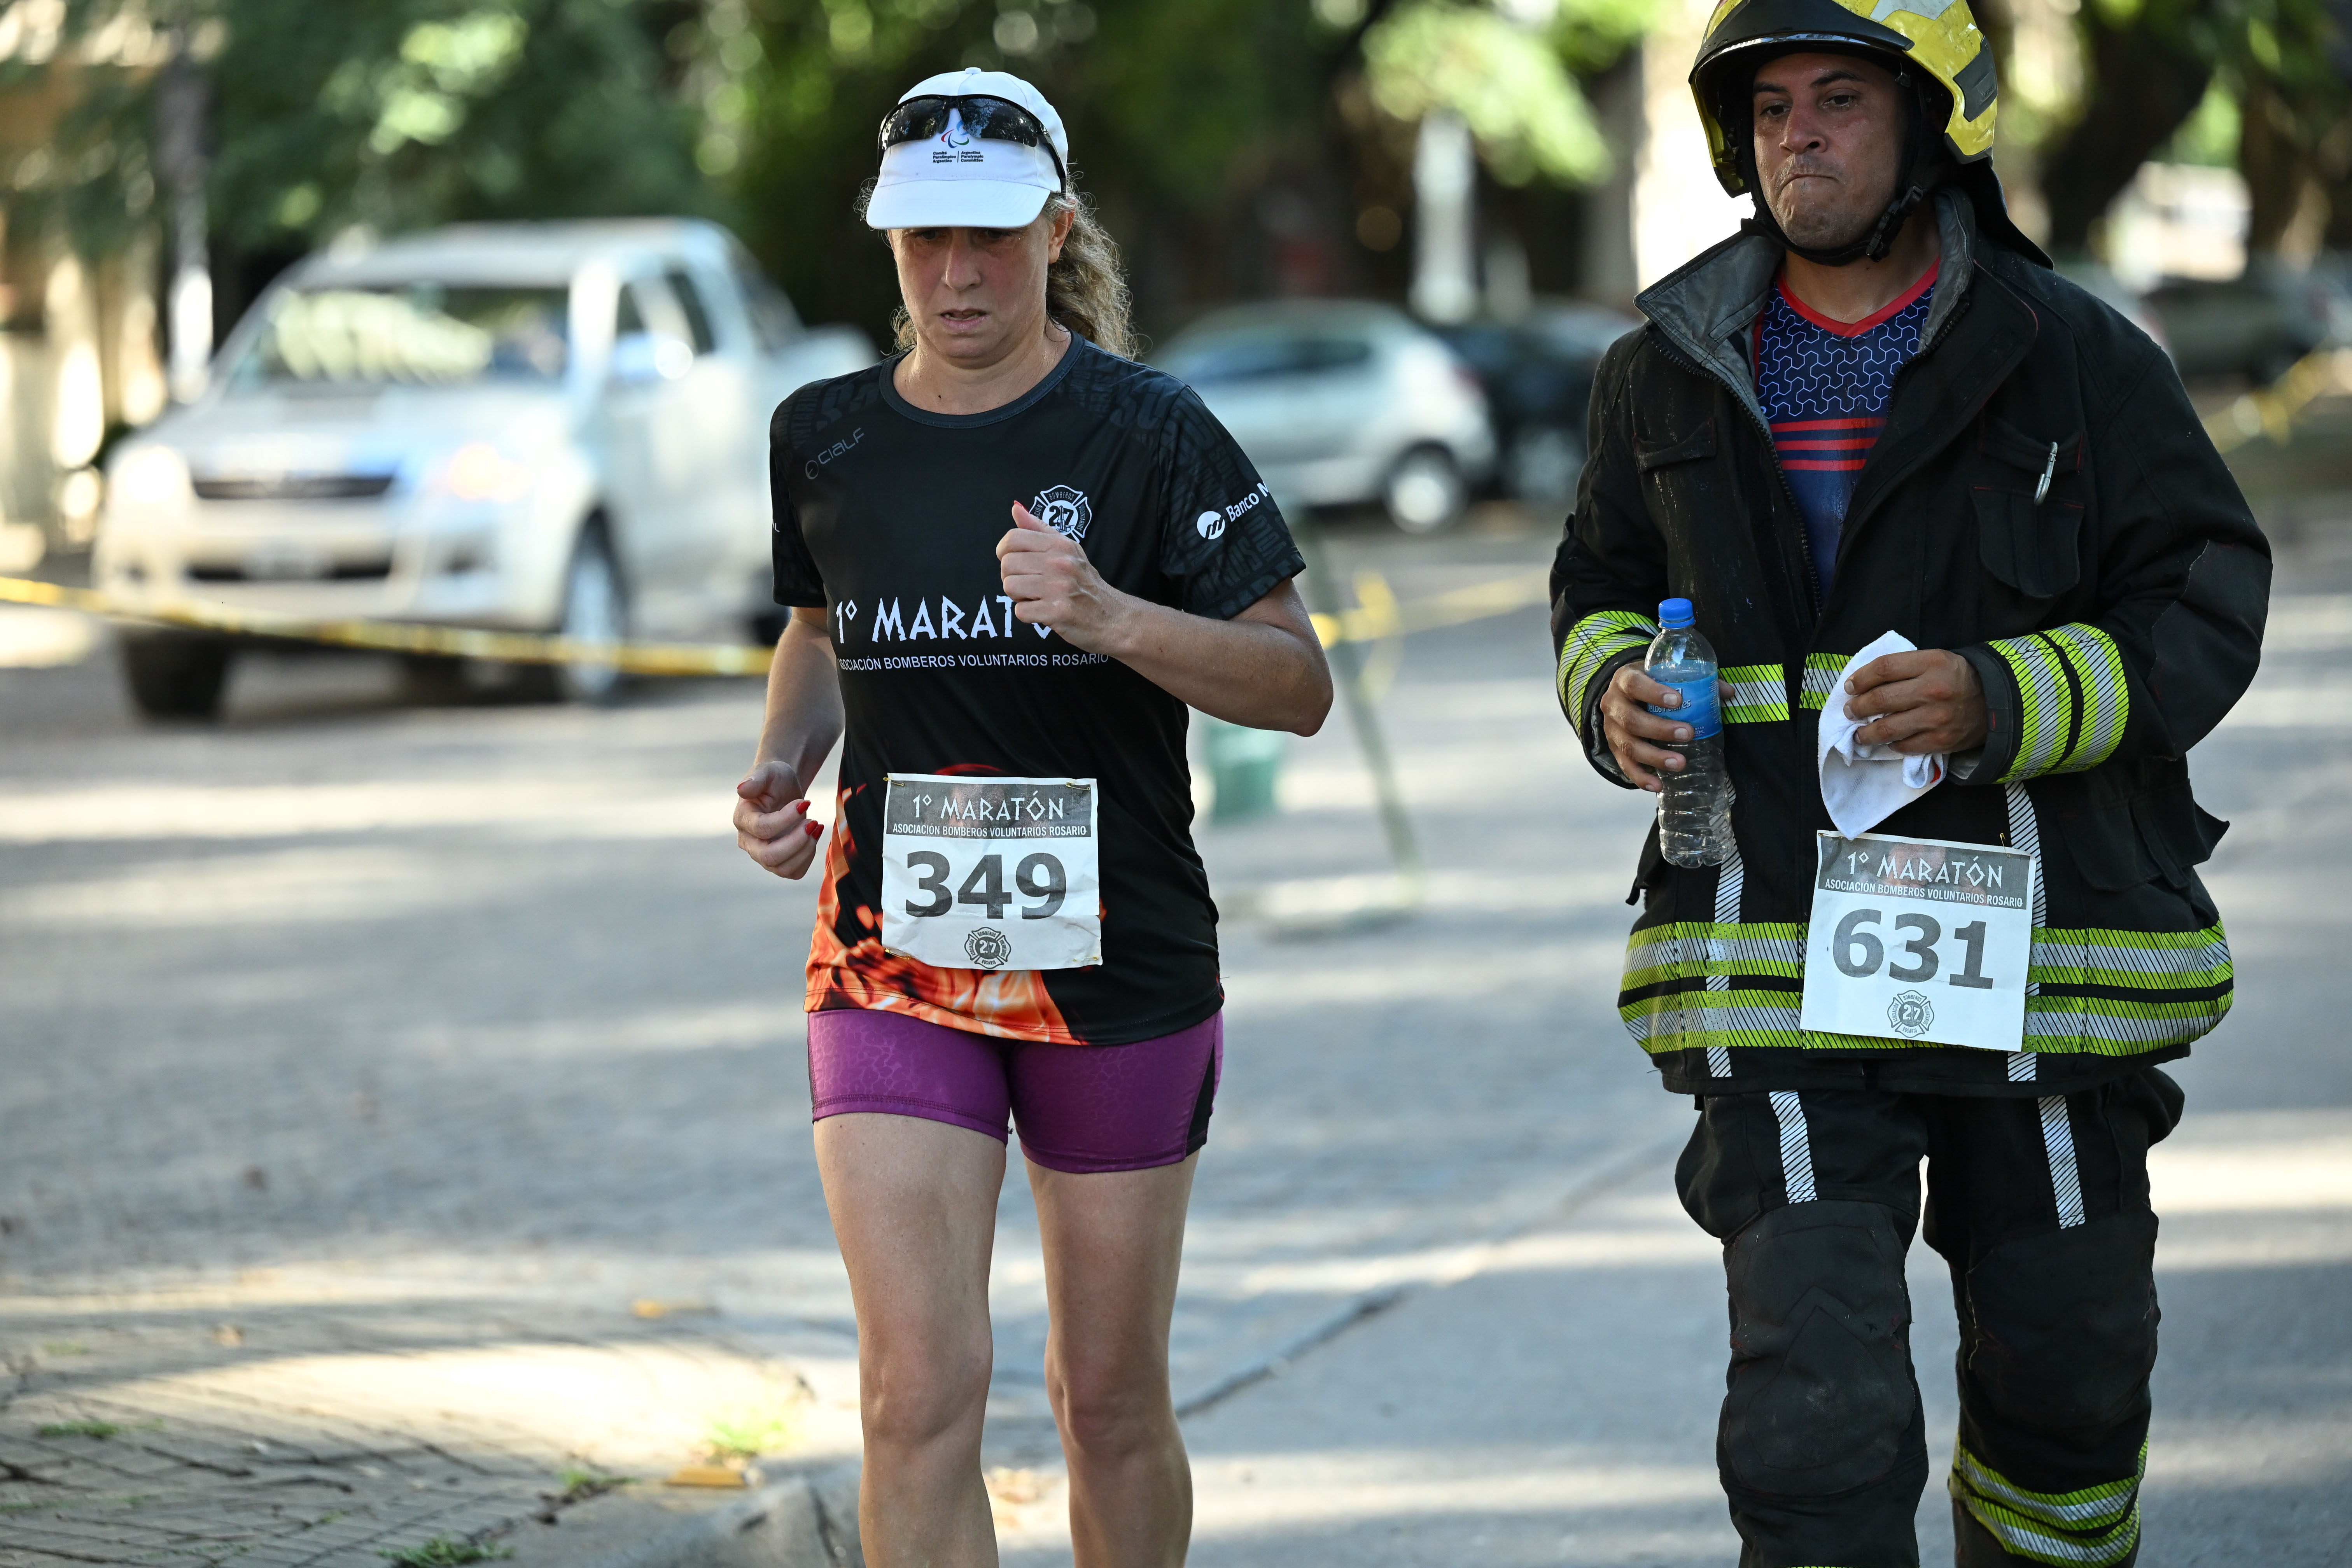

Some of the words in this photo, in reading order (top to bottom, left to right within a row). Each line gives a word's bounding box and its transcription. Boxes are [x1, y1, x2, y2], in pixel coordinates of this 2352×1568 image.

[1048, 491, 1074, 500] BOMBEROS
[1225, 493, 1259, 522] Banco
[1256, 481, 1269, 497] M
[1048, 505, 1074, 527] 27
[872, 595, 1052, 643] MARAT
[884, 655, 956, 669] BOMBEROS
[958, 654, 1048, 666] VOLUNTARIOS
[1052, 653, 1109, 666] ROSARIO
[940, 790, 1064, 821] MARATÓN
[892, 823, 940, 835] ASOCIACIÓN
[943, 826, 988, 837] BOMBEROS
[990, 827, 1047, 837] VOLUNTARIOS
[1049, 825, 1087, 836] ROSARIO
[906, 850, 1066, 920] 349
[1876, 854, 2002, 889] MARATÓN
[1825, 878, 1875, 893] ASOCIACIÓN
[1878, 884, 1925, 898] BOMBEROS
[1927, 889, 1984, 903] VOLUNTARIOS
[1987, 894, 2023, 907] ROSARIO
[979, 940, 997, 953] 27
[1832, 908, 1994, 990] 631
[1902, 1004, 1921, 1020] 27
